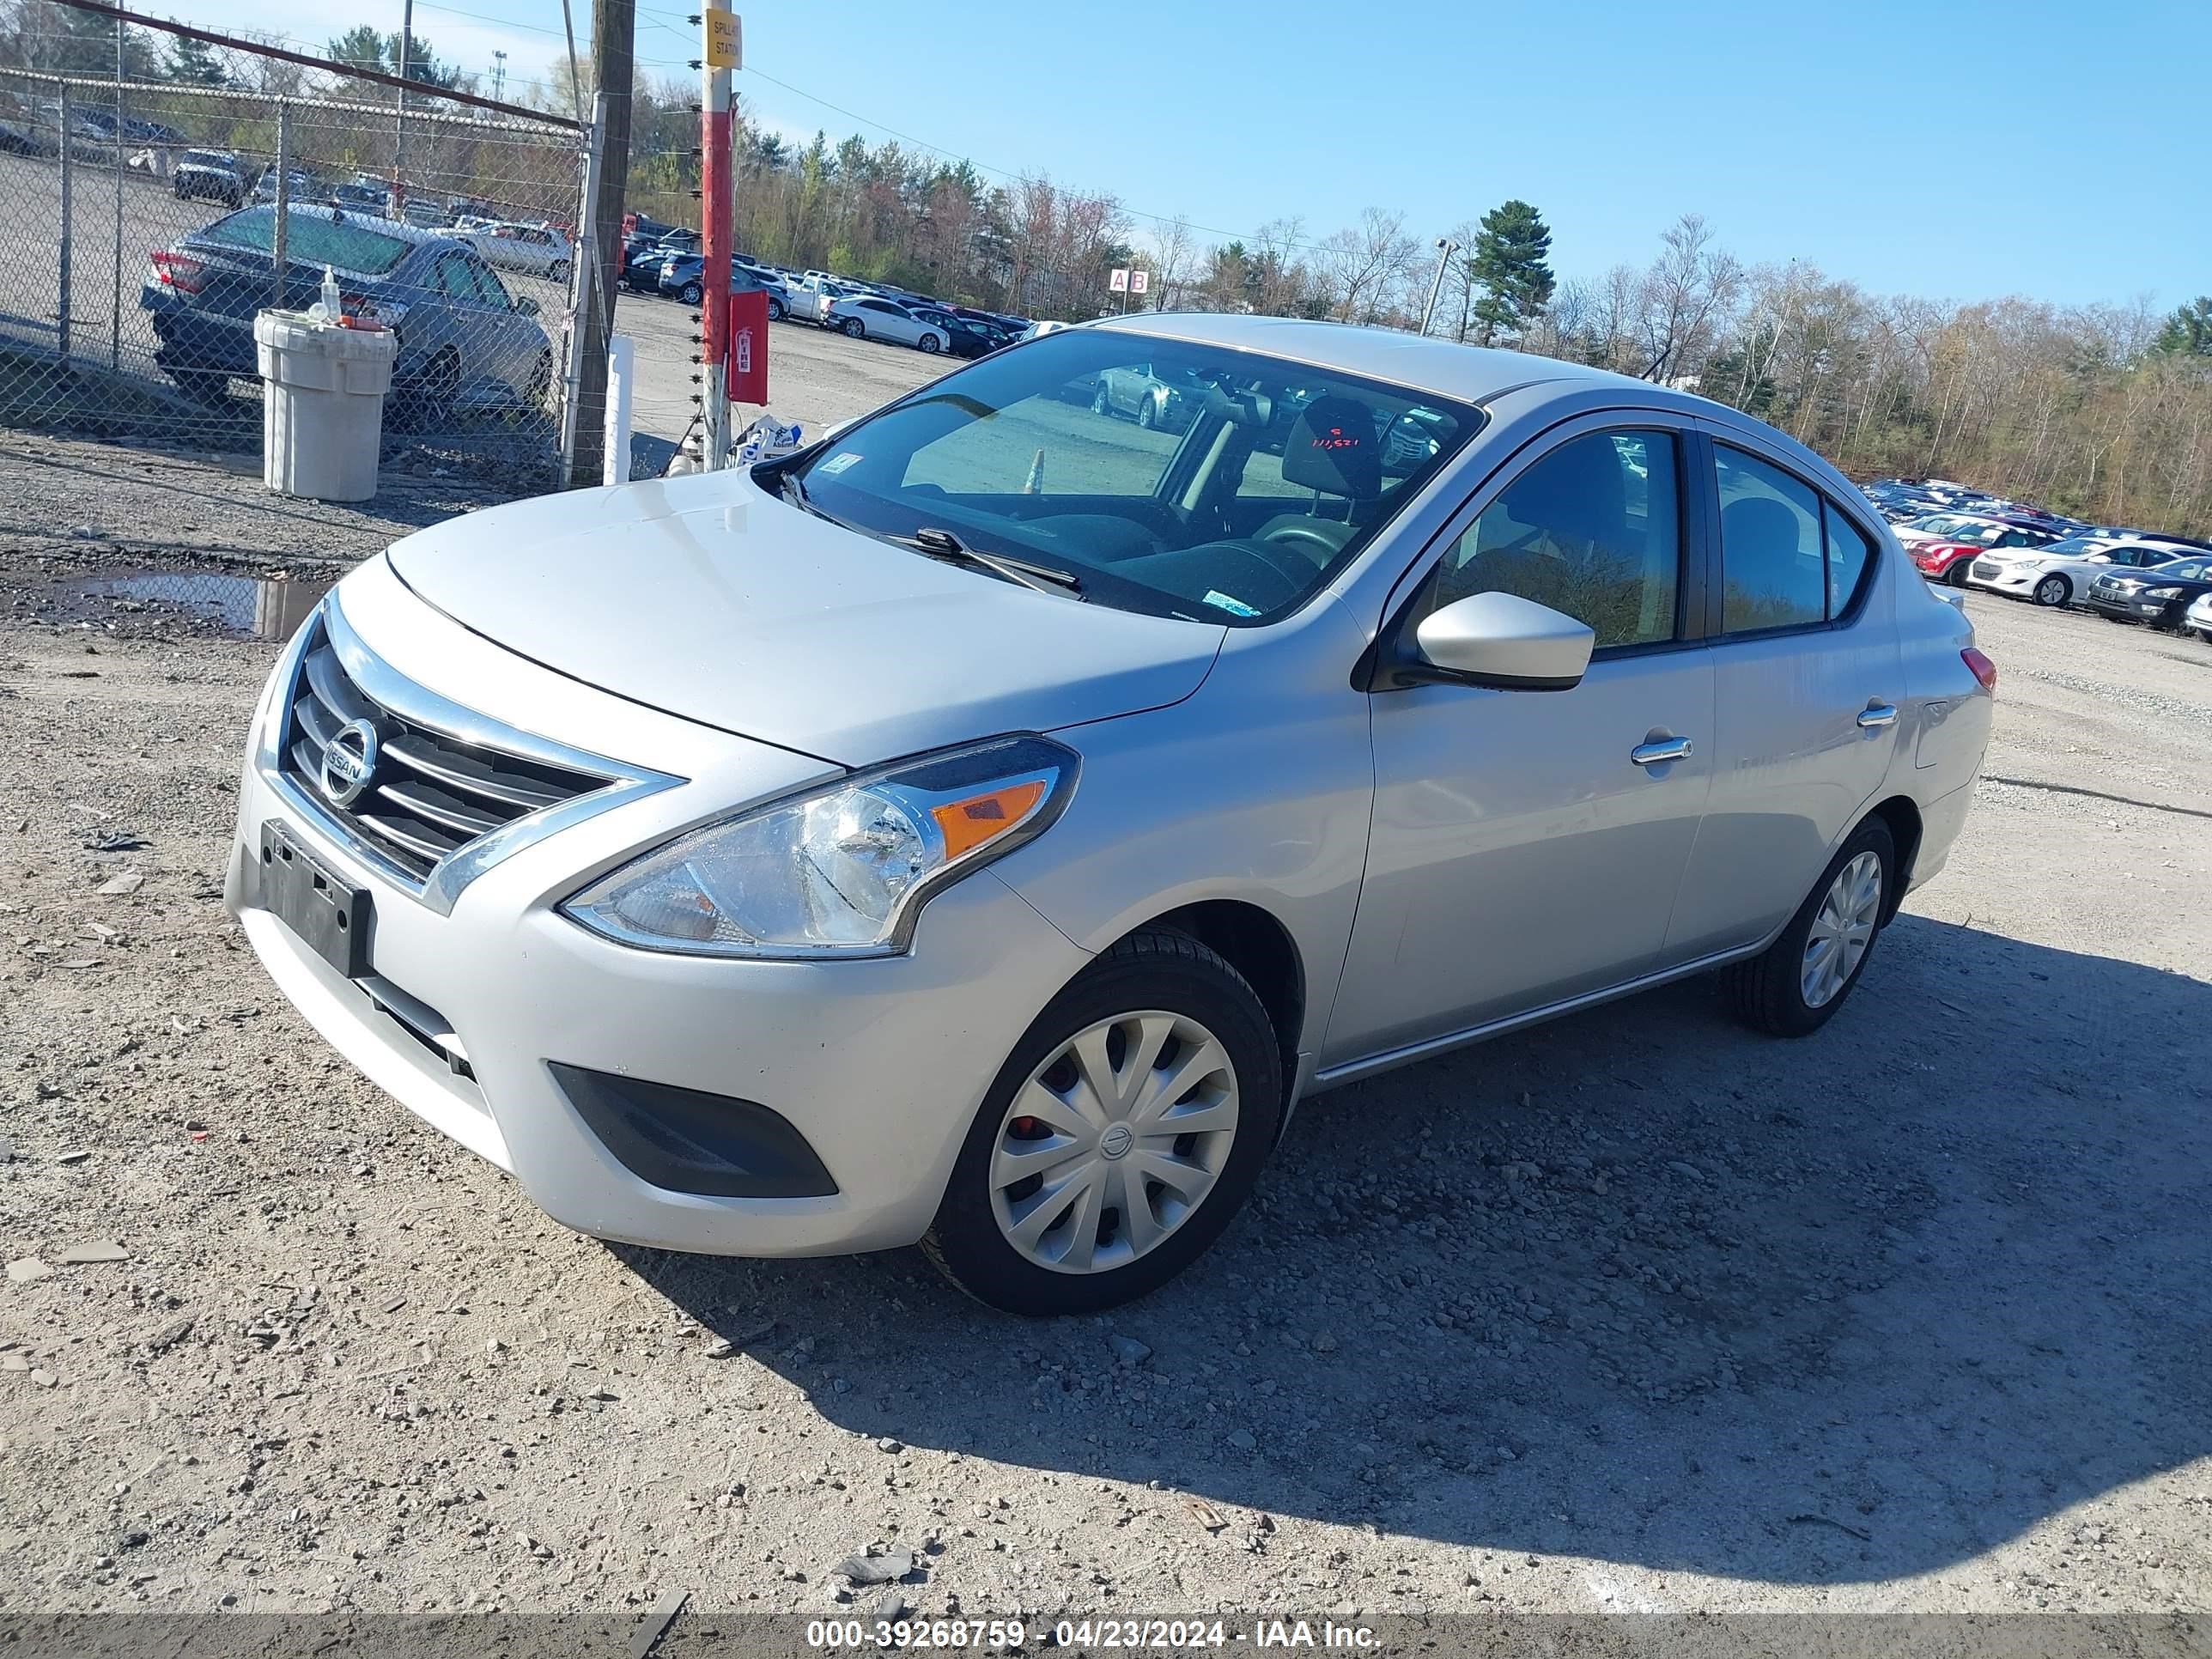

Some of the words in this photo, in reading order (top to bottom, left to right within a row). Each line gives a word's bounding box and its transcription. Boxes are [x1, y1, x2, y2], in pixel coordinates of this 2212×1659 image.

[716, 41, 738, 57] STATIO
[1113, 272, 1124, 289] A
[1133, 273, 1145, 290] B
[740, 338, 749, 368] FIRE
